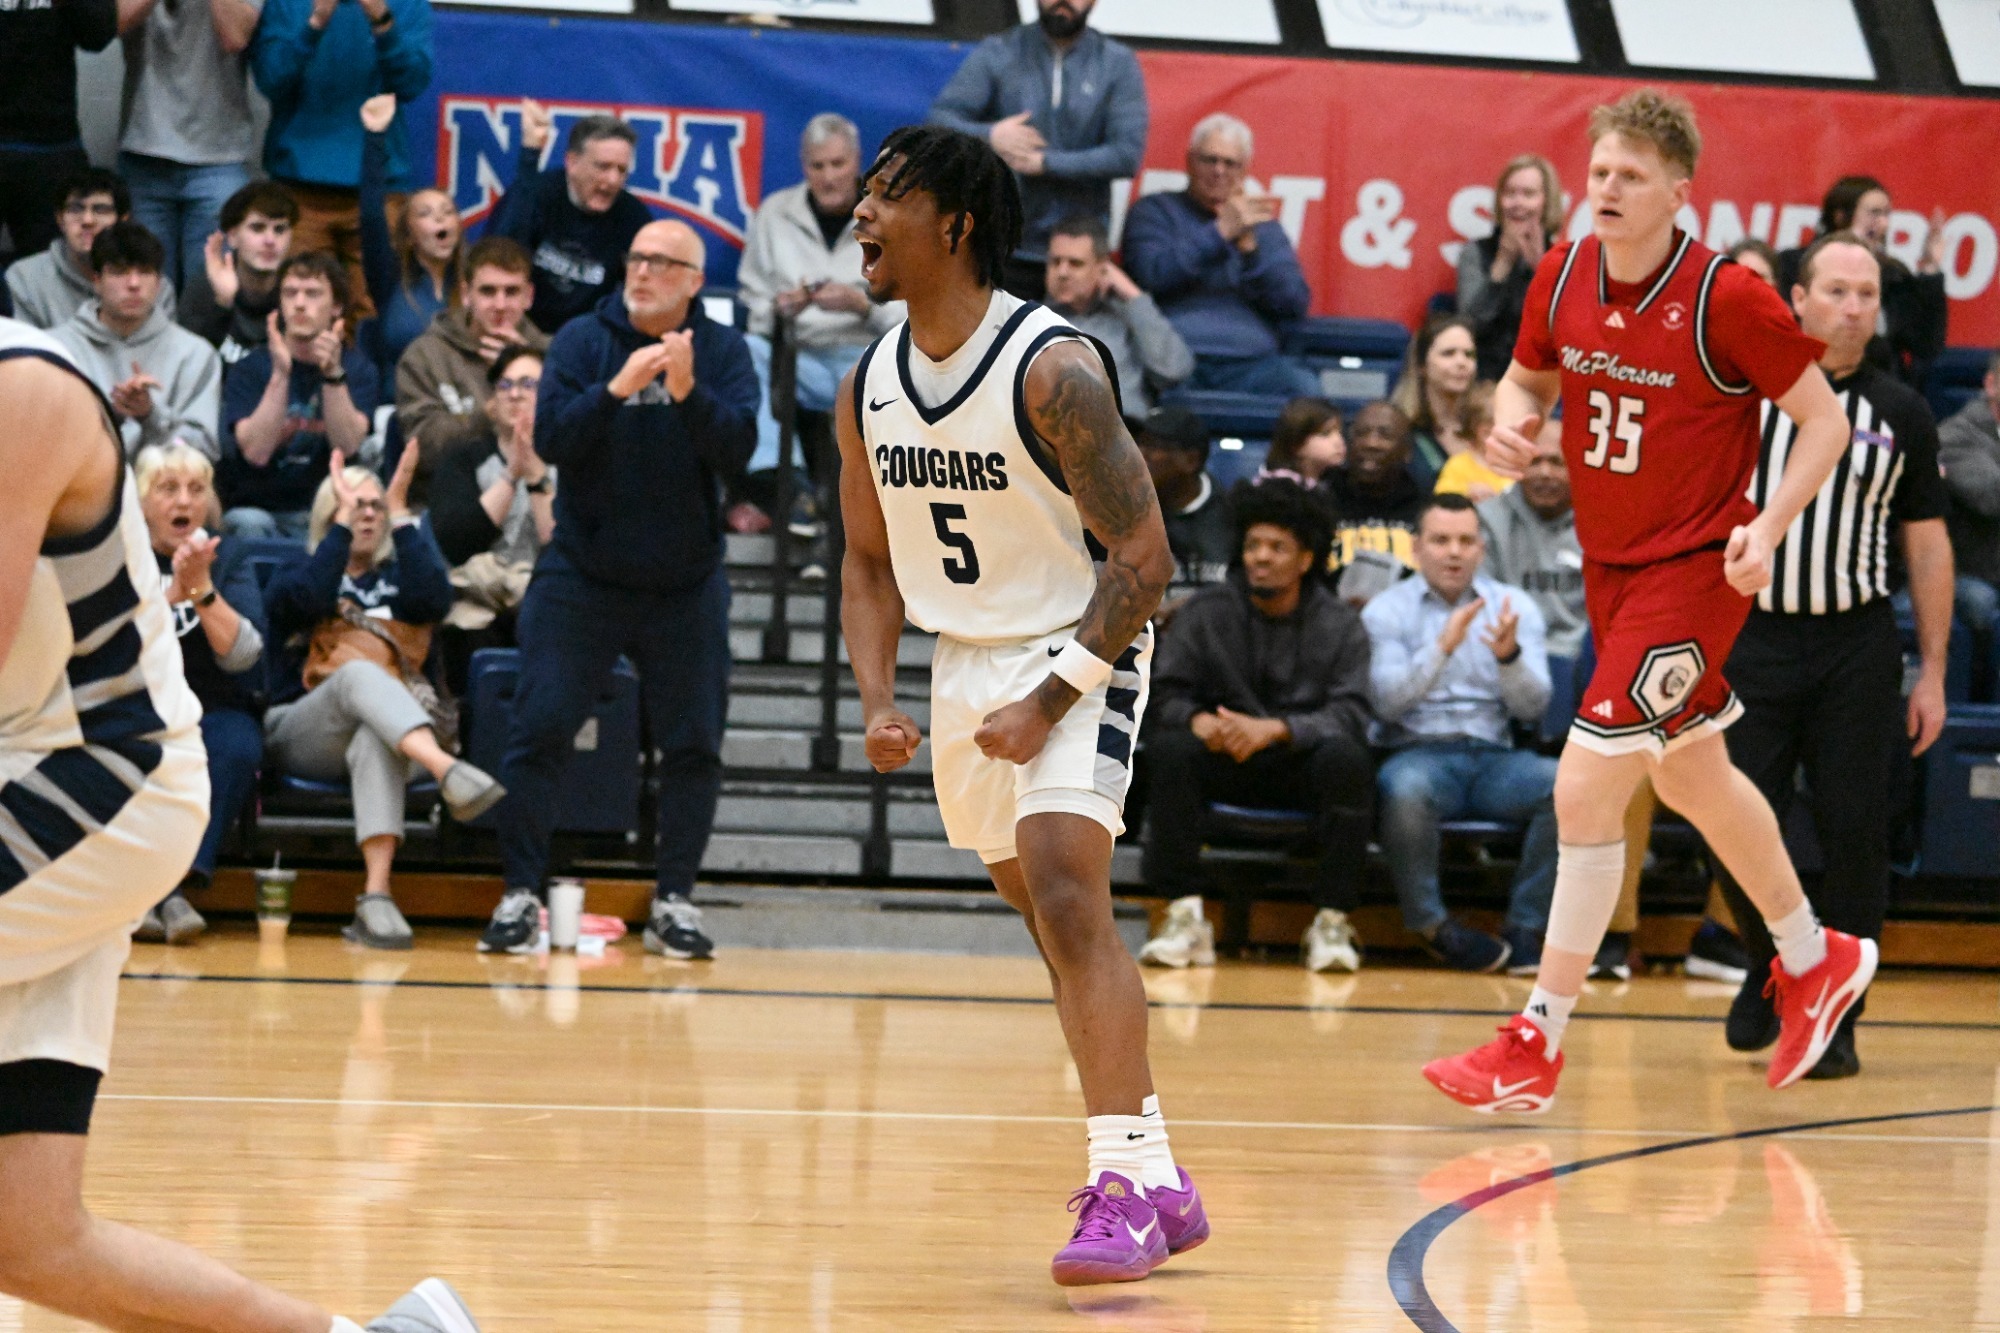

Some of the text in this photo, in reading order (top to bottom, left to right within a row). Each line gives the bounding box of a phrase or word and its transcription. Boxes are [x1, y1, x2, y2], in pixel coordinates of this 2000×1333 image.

[1341, 178, 1417, 269] &
[1561, 345, 1677, 388] McPherson
[876, 444, 1009, 491] COUGARS
[1583, 389, 1645, 474] 35
[929, 502, 980, 585] 5
